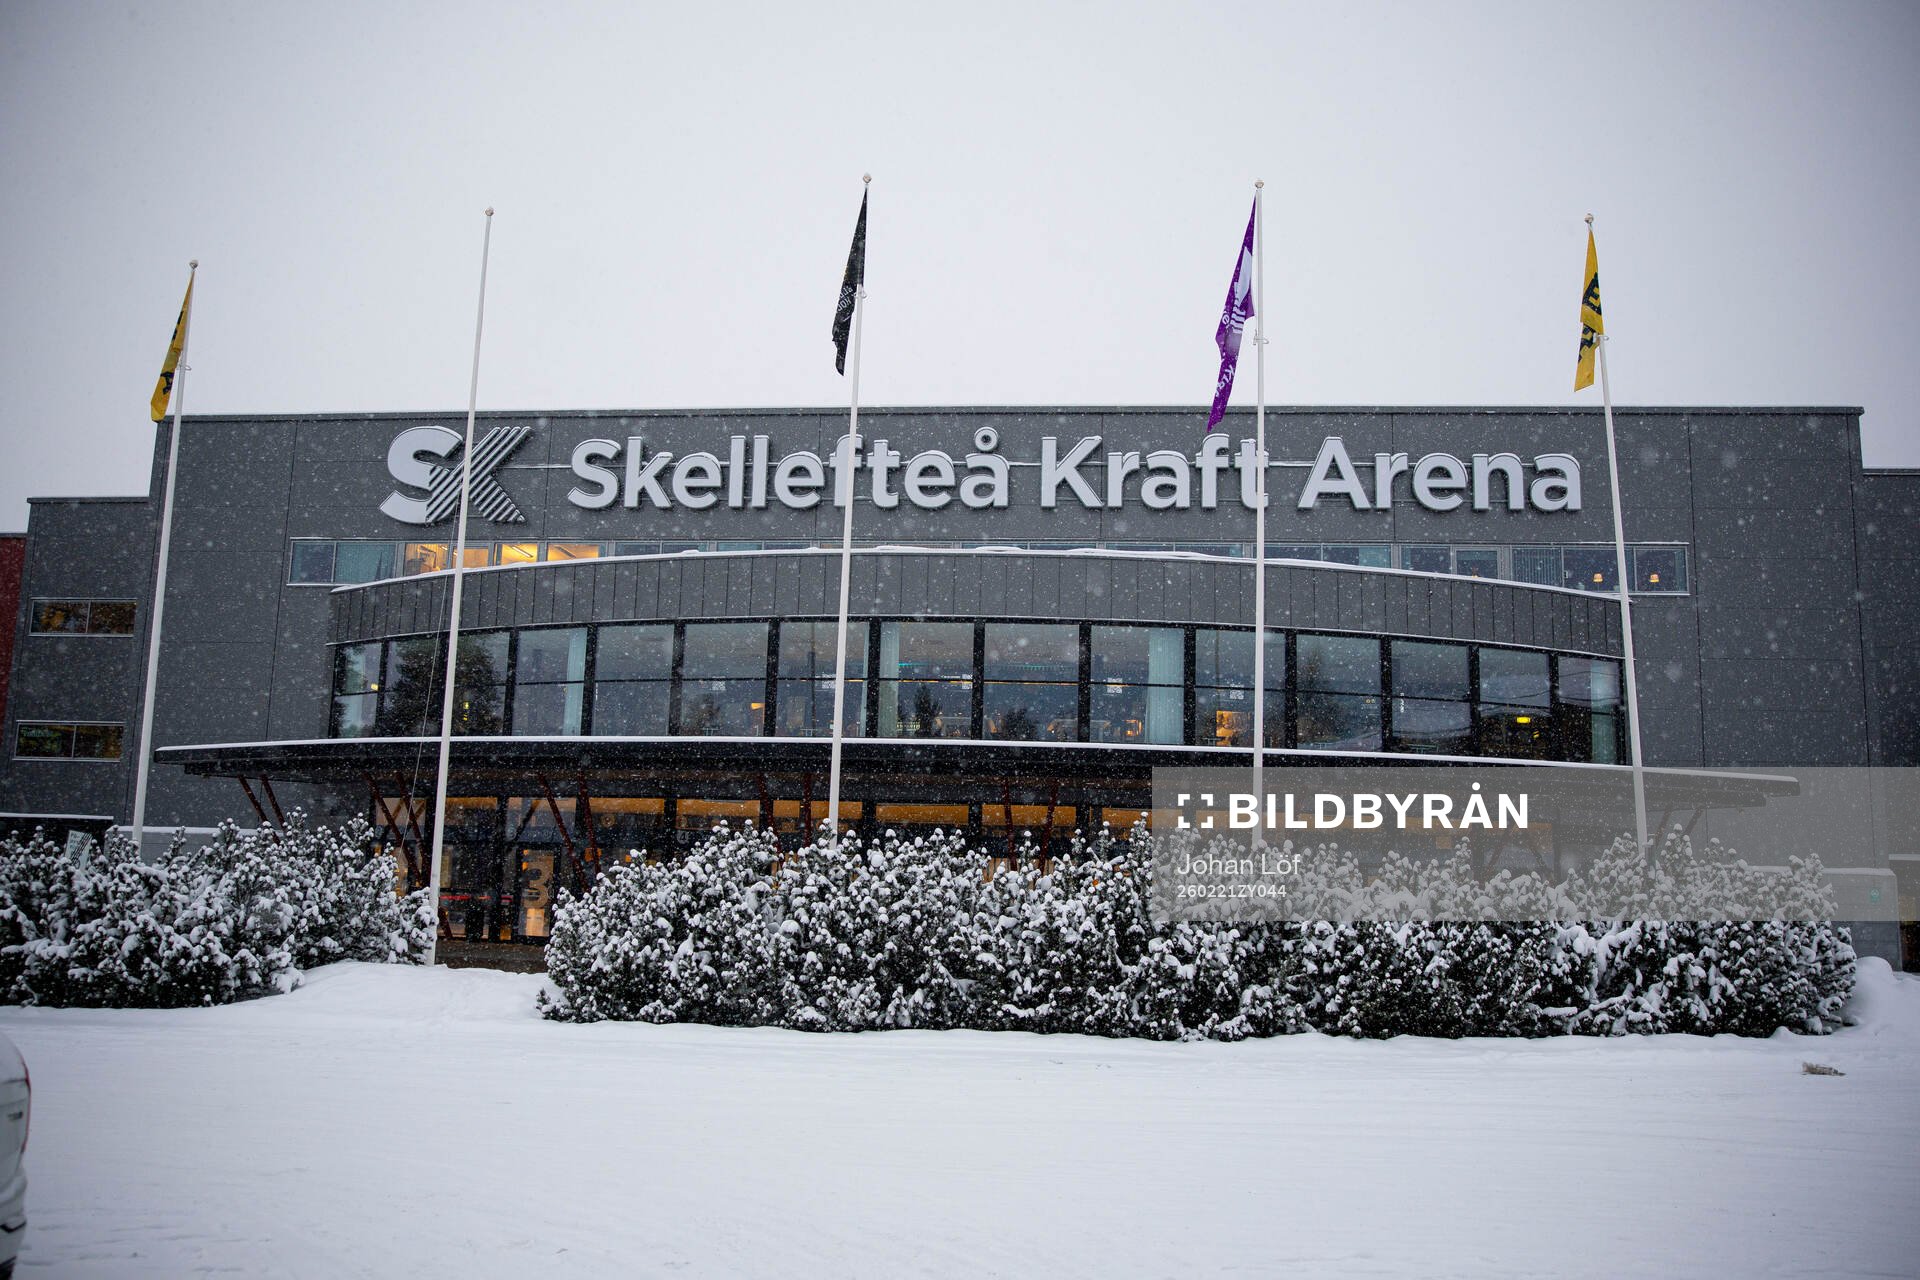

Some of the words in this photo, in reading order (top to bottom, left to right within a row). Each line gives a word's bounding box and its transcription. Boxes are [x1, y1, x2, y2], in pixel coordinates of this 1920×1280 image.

[567, 426, 1009, 510] Skellefteå
[1041, 433, 1269, 509] Kraft
[1298, 435, 1582, 511] Arena
